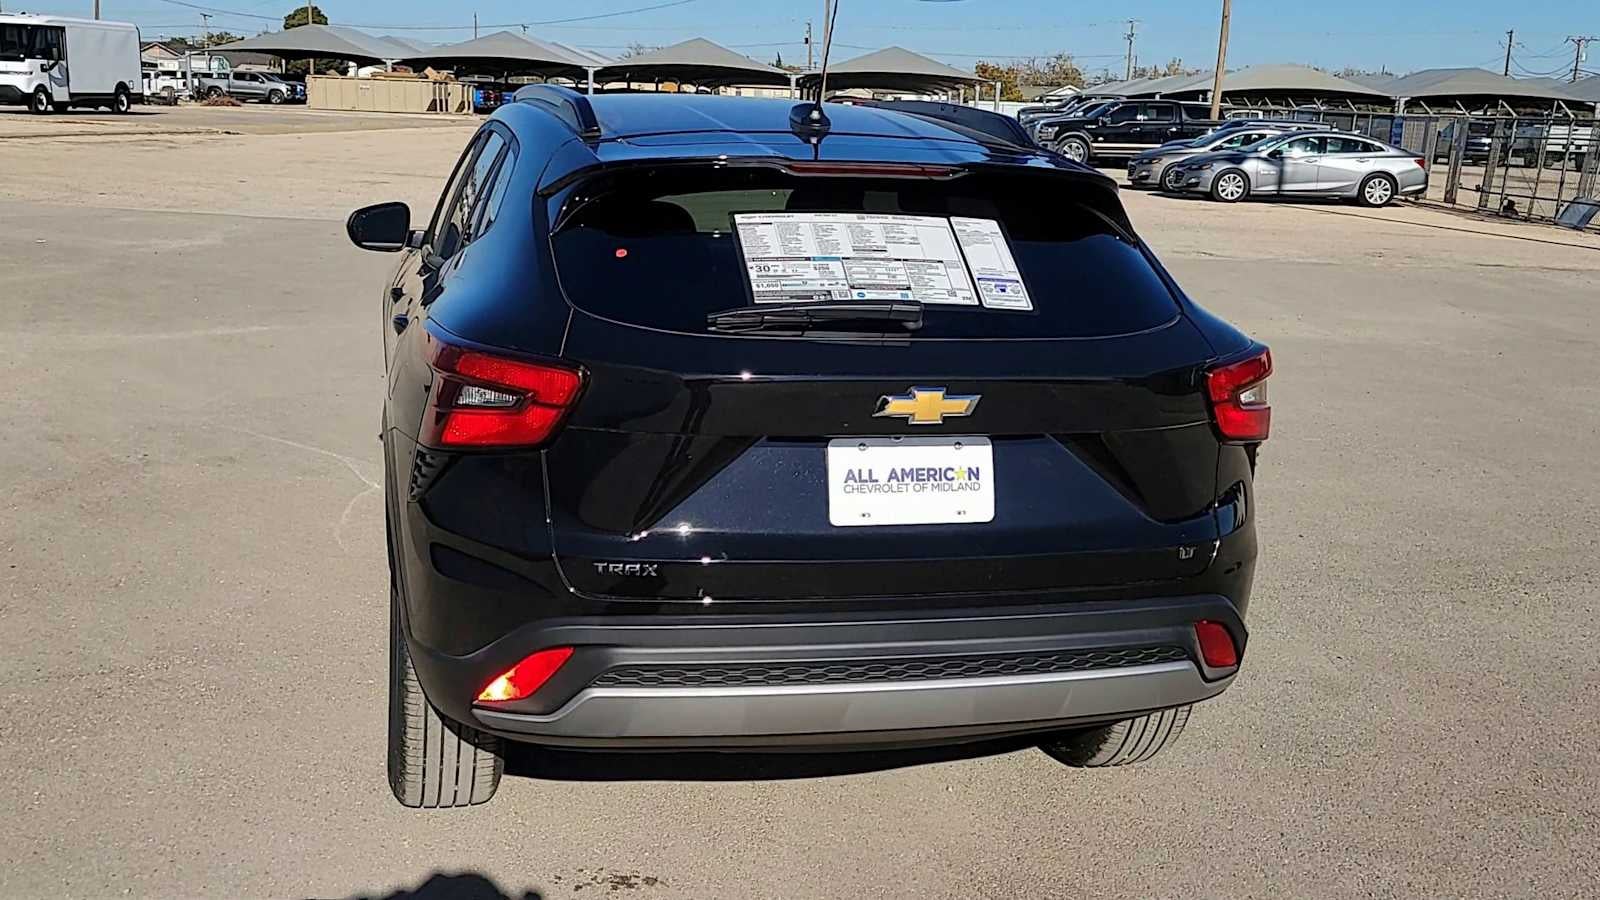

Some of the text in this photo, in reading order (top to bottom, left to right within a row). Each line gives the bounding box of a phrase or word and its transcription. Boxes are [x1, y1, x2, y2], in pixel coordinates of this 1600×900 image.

[844, 468, 879, 484] ALL
[843, 481, 981, 494] CHEVROLET OF MIDLAND
[592, 561, 658, 577] TRAX
